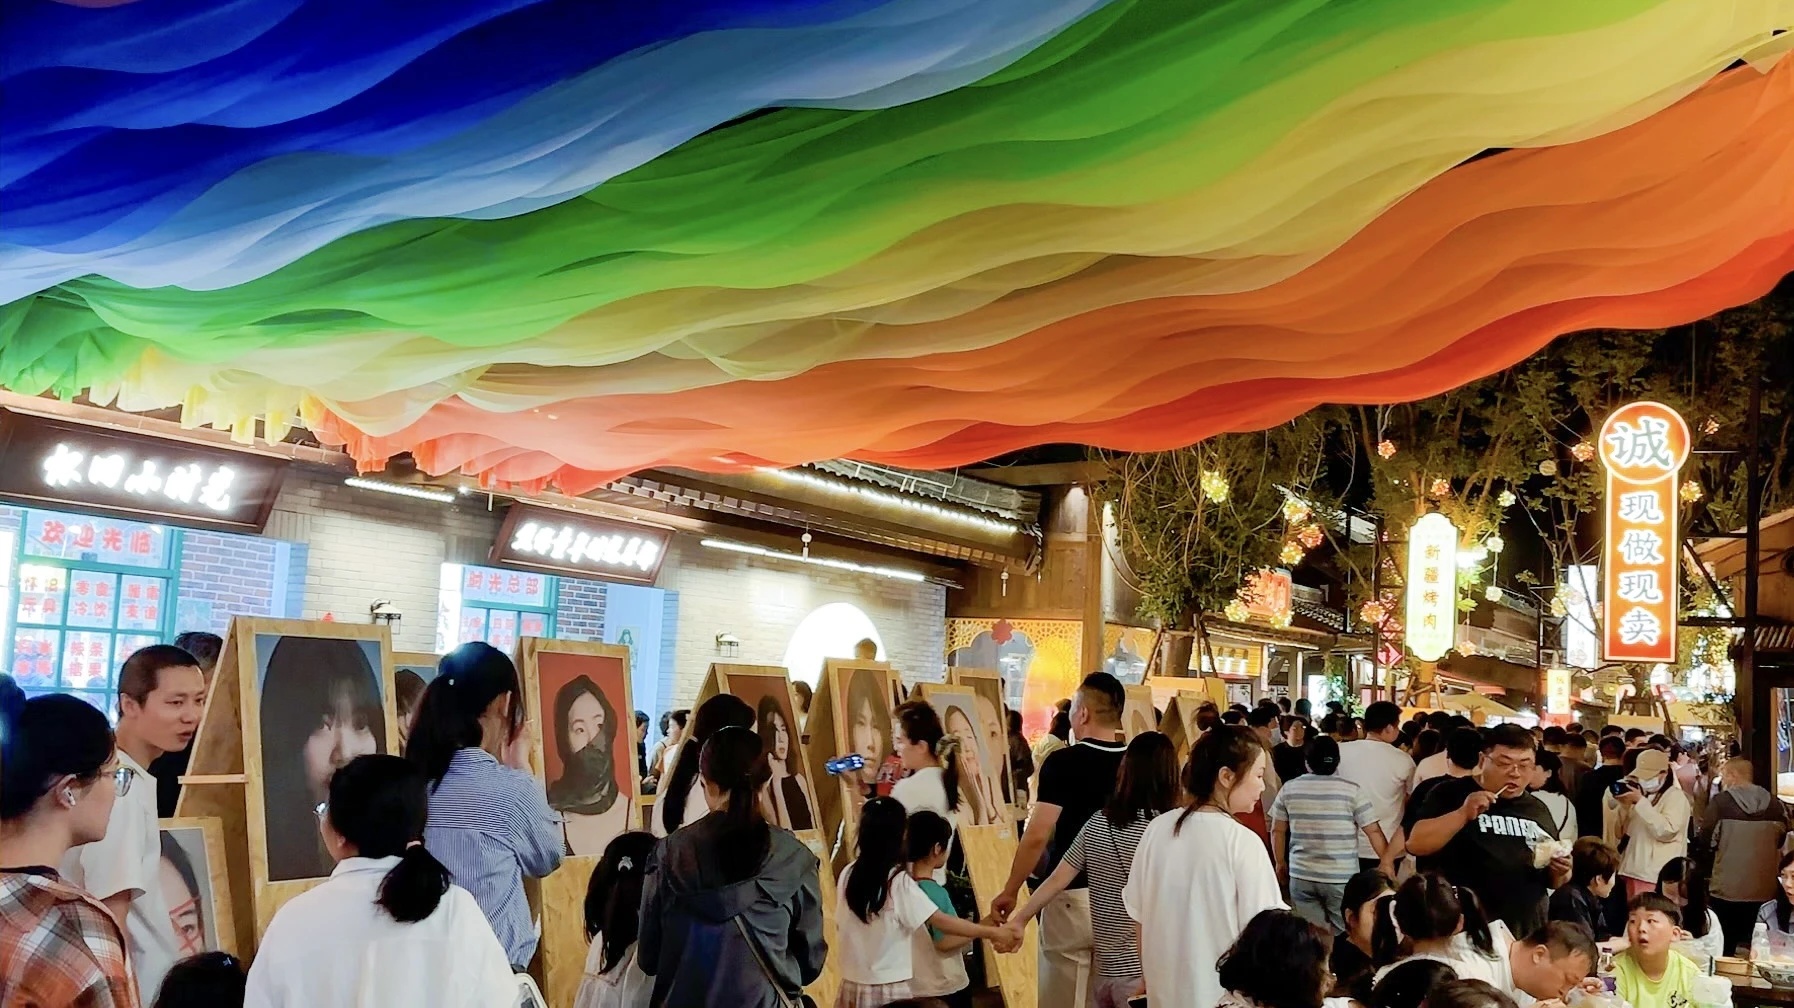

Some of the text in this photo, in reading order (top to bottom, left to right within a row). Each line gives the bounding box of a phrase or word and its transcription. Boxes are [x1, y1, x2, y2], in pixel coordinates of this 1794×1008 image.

[1608, 418, 1673, 469] 诚
[42, 520, 152, 554] 欢迎光临
[467, 570, 539, 596] 时光总部
[1619, 492, 1662, 643] 现做现卖
[1423, 544, 1441, 630] 新疆烤肉
[74, 601, 108, 618] 冷饮
[69, 661, 102, 677] 糖果
